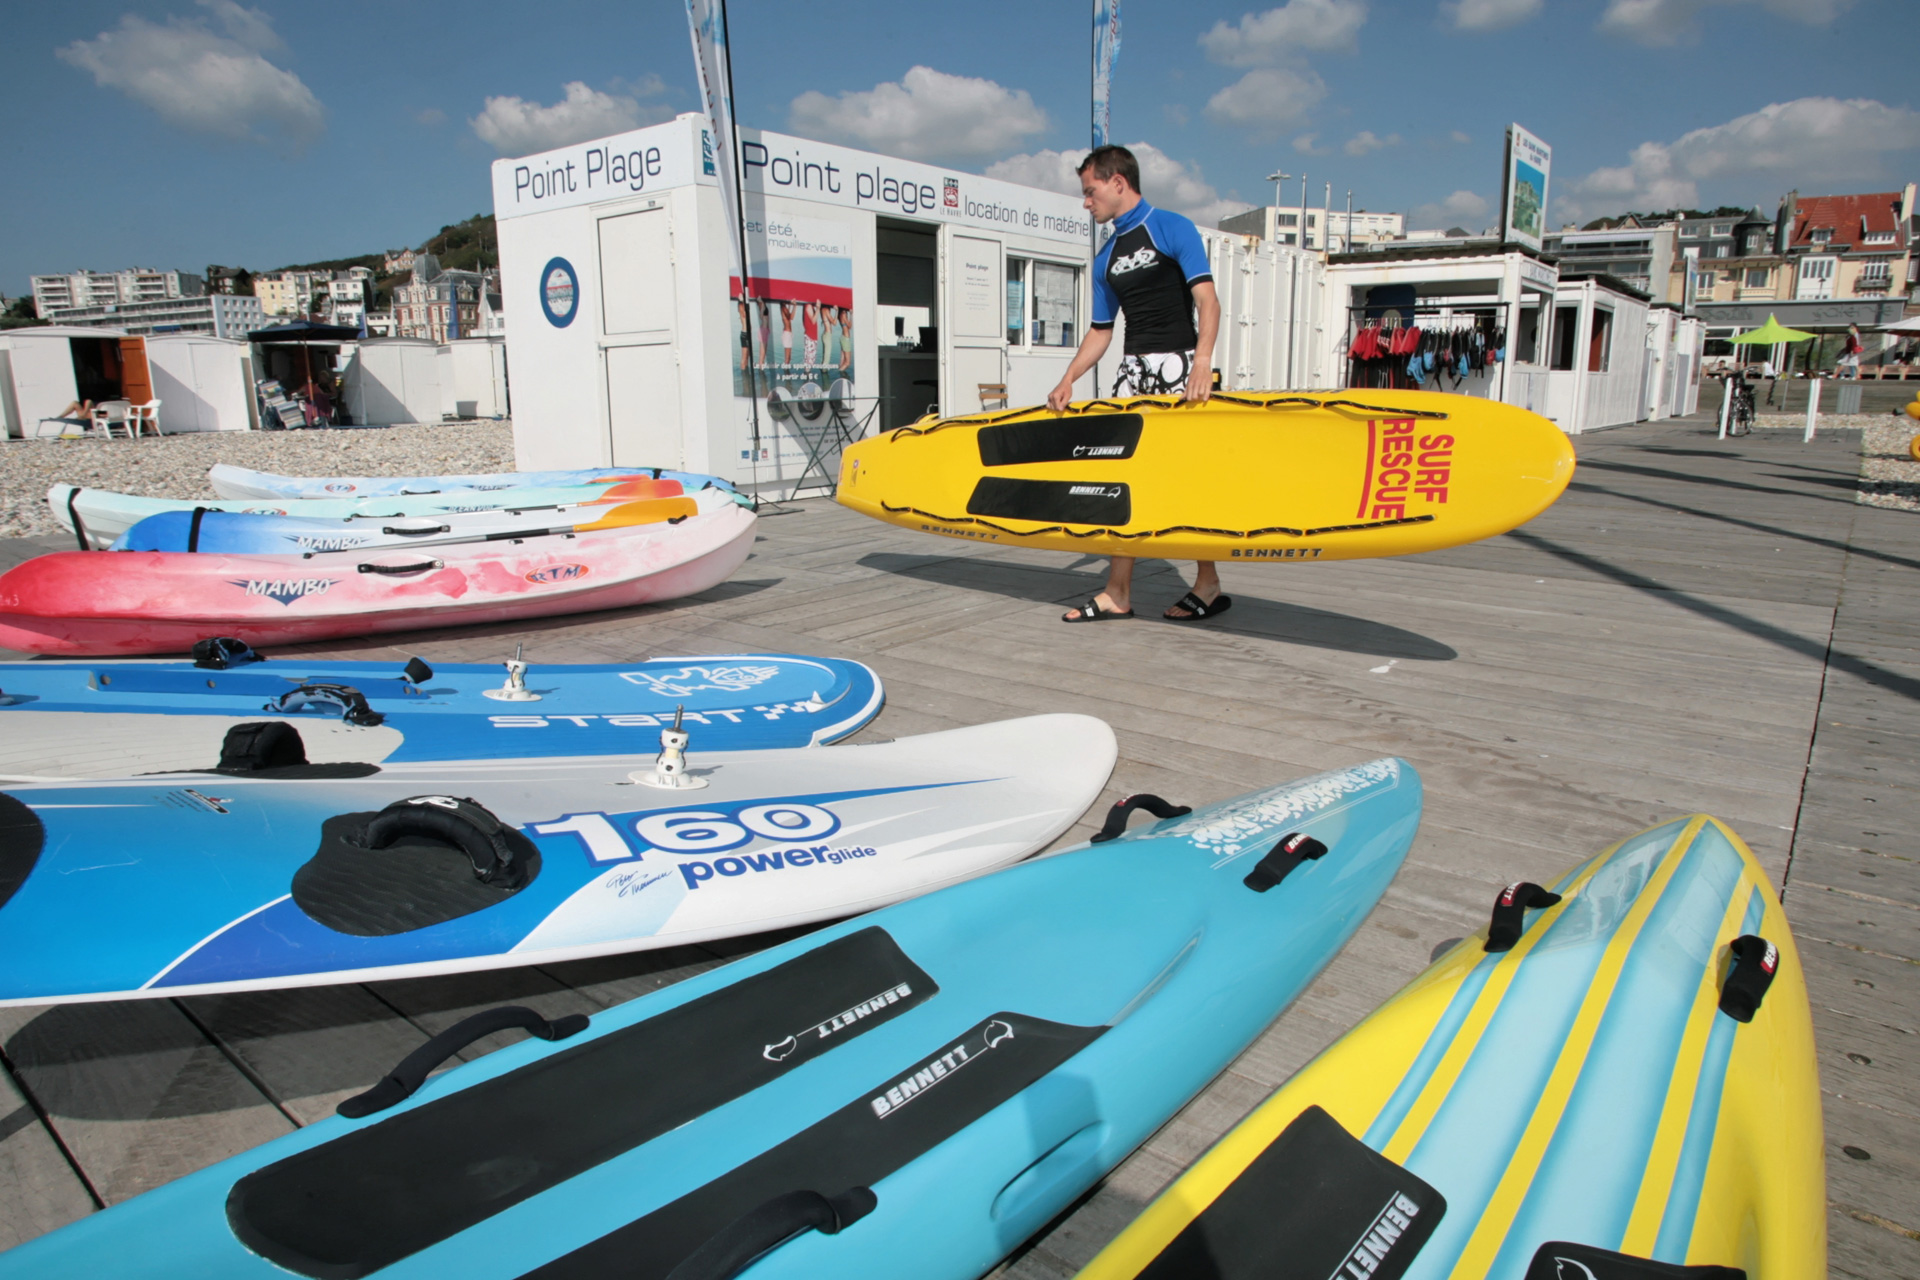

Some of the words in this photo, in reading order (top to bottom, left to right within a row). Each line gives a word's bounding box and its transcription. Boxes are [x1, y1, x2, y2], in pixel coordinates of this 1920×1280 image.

[515, 160, 577, 203] Point
[586, 146, 662, 191] Plage
[742, 140, 841, 193] Point
[856, 166, 936, 214] plage
[768, 221, 797, 238] été,
[964, 195, 1018, 224] location
[1023, 208, 1039, 228] de
[1044, 216, 1092, 238] matériel
[768, 238, 839, 254] mouillez-vous
[1088, 446, 1125, 456] BENNETT
[1371, 418, 1416, 519] RESCUE
[1414, 434, 1455, 504] SURF
[1069, 485, 1106, 495] BENNETT
[298, 535, 361, 550] MAMBO
[921, 524, 1000, 540] BENNETT
[1231, 548, 1323, 558] BENNETT
[245, 578, 331, 596] MAMBO
[530, 565, 581, 582] RTM
[526, 802, 841, 868] 160
[818, 983, 912, 1038] BENNETT
[871, 1044, 969, 1116] BENNETT
[1335, 1193, 1420, 1280] BENNET
